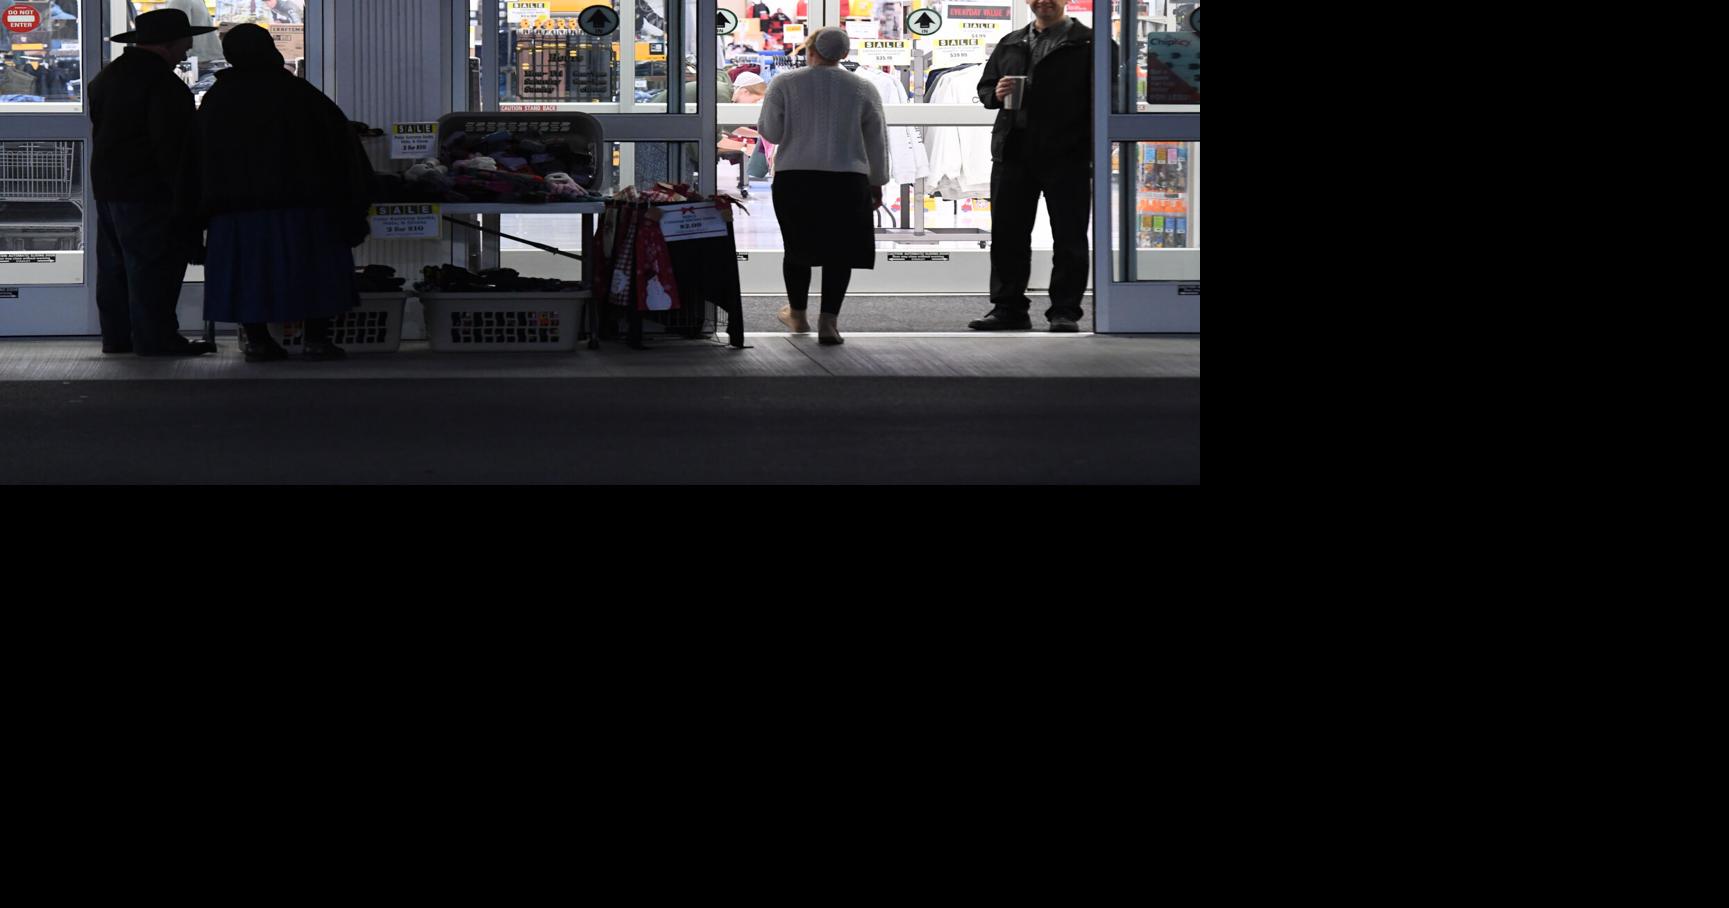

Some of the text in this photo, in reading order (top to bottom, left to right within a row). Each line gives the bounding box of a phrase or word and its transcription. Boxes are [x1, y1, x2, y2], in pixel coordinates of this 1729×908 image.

[984, 9, 1002, 17] VALUE
[398, 124, 433, 134] SALE
[377, 205, 433, 216] SALE
